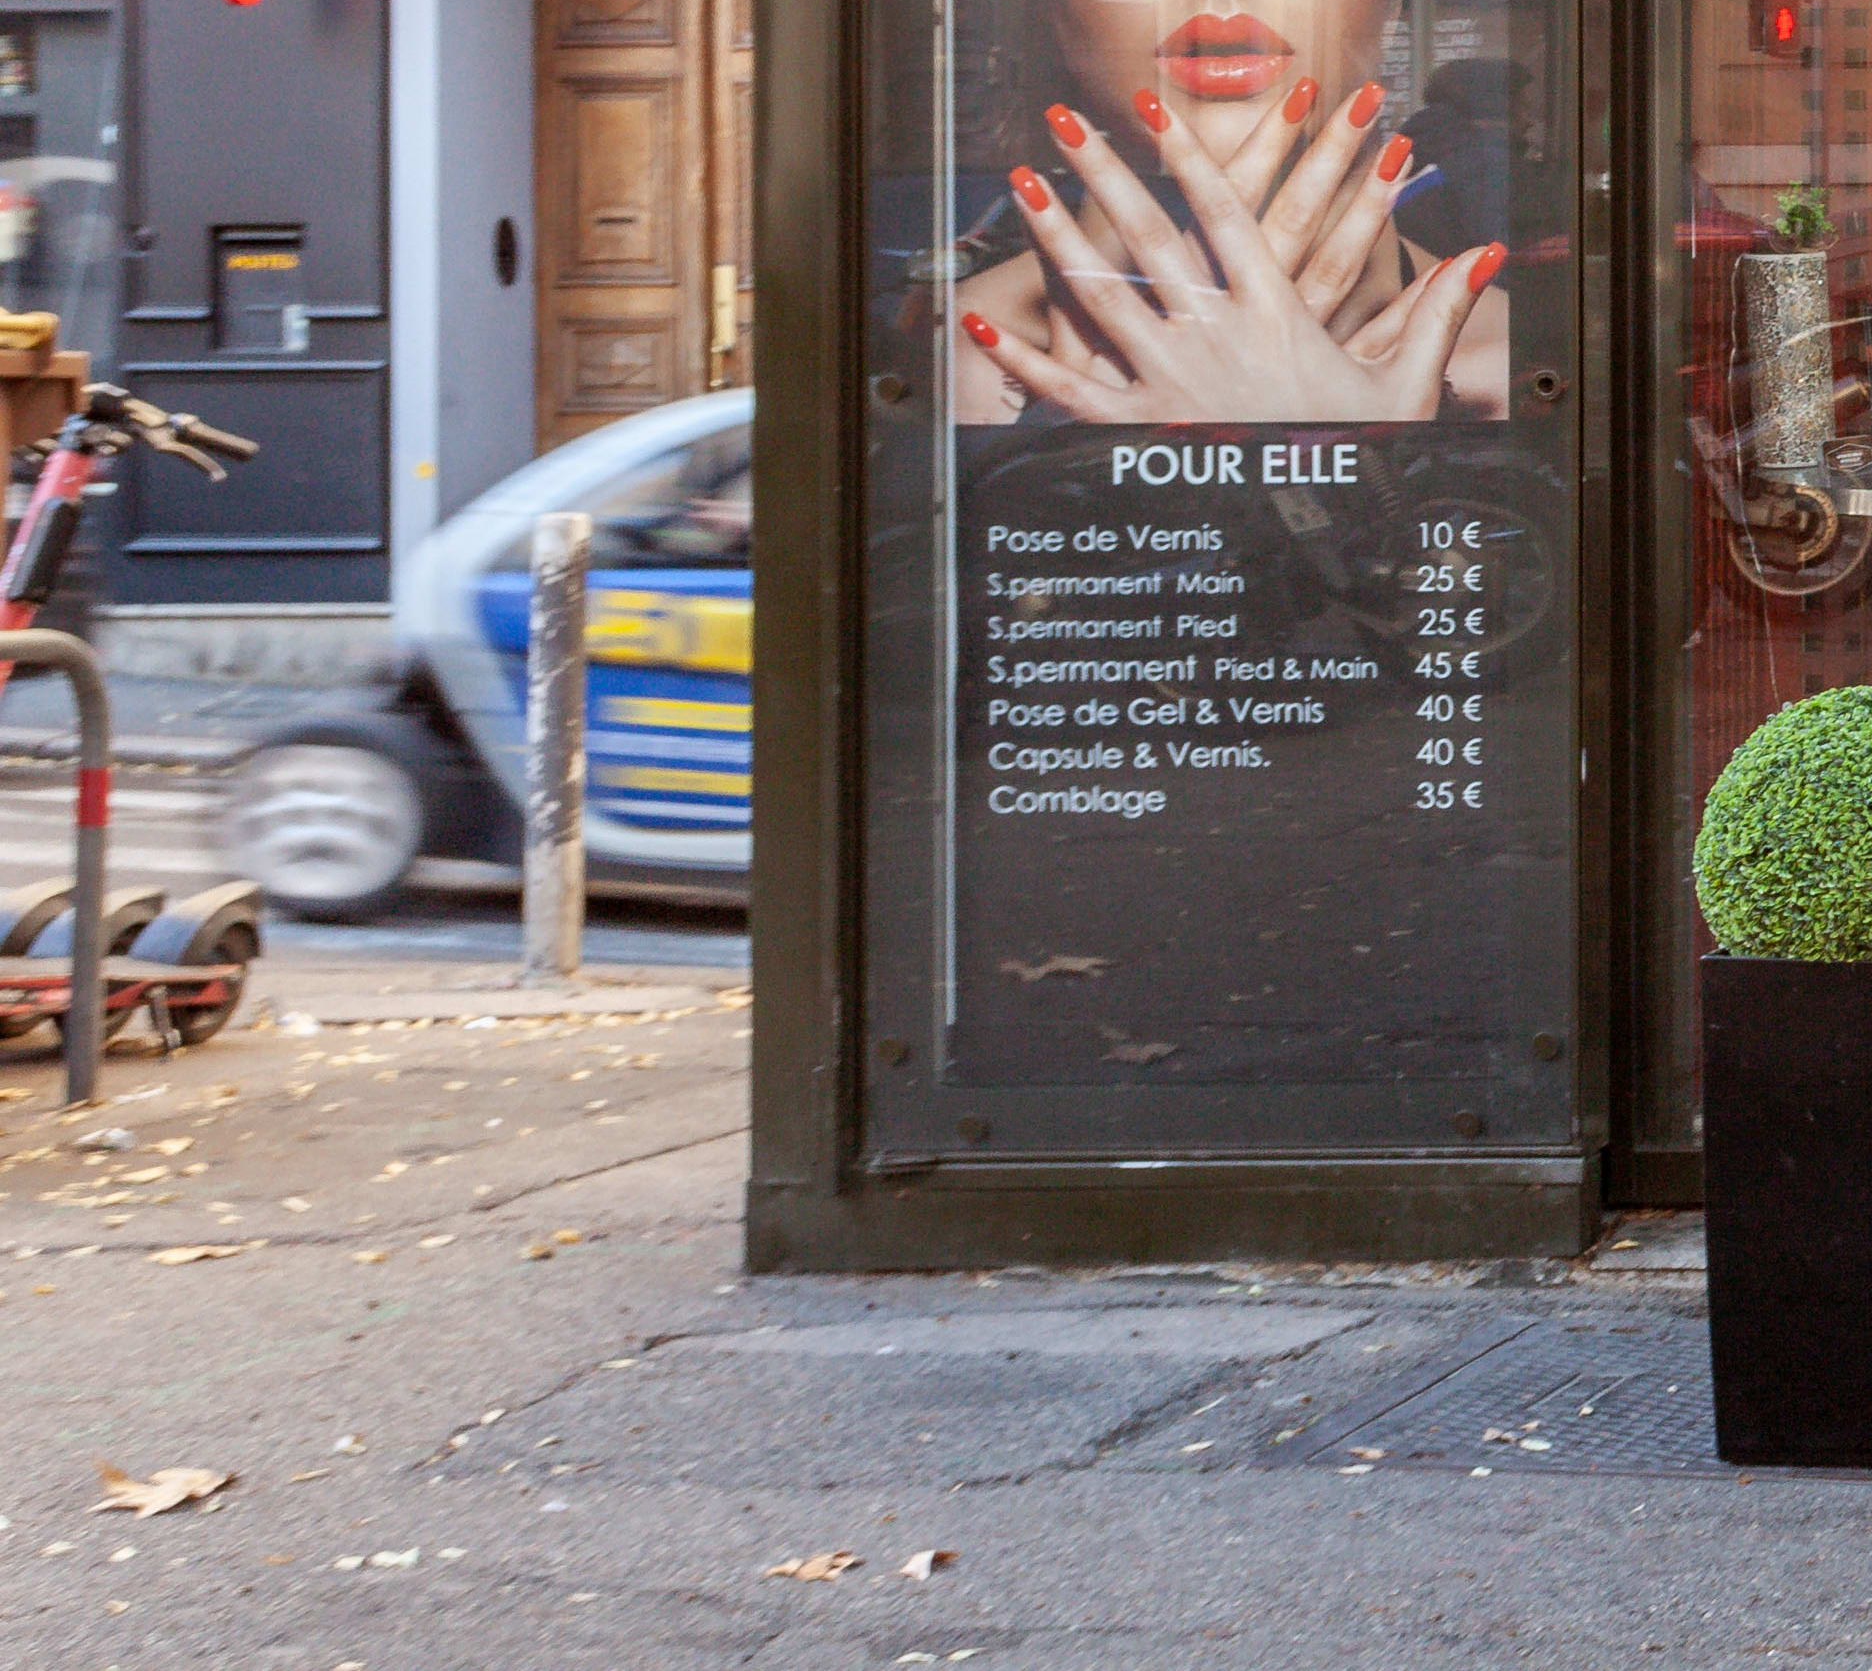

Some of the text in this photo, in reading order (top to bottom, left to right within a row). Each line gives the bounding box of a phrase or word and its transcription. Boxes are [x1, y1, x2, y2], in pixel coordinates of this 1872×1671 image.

[1112, 444, 1358, 485] POUR ELLE
[988, 521, 1481, 553] Pose de Vernis 10 €
[987, 564, 1483, 599] S.permanent Main 25 €
[988, 607, 1484, 641] S.permanent Pied 25 €
[988, 651, 1481, 688] S.permanent Pied & Main 45 €
[989, 694, 1483, 726] Pose de Gel & Vernis 40 €
[988, 737, 1483, 775] Capsule & Vernis. 40 €
[989, 781, 1483, 819] Comblage 35 €
